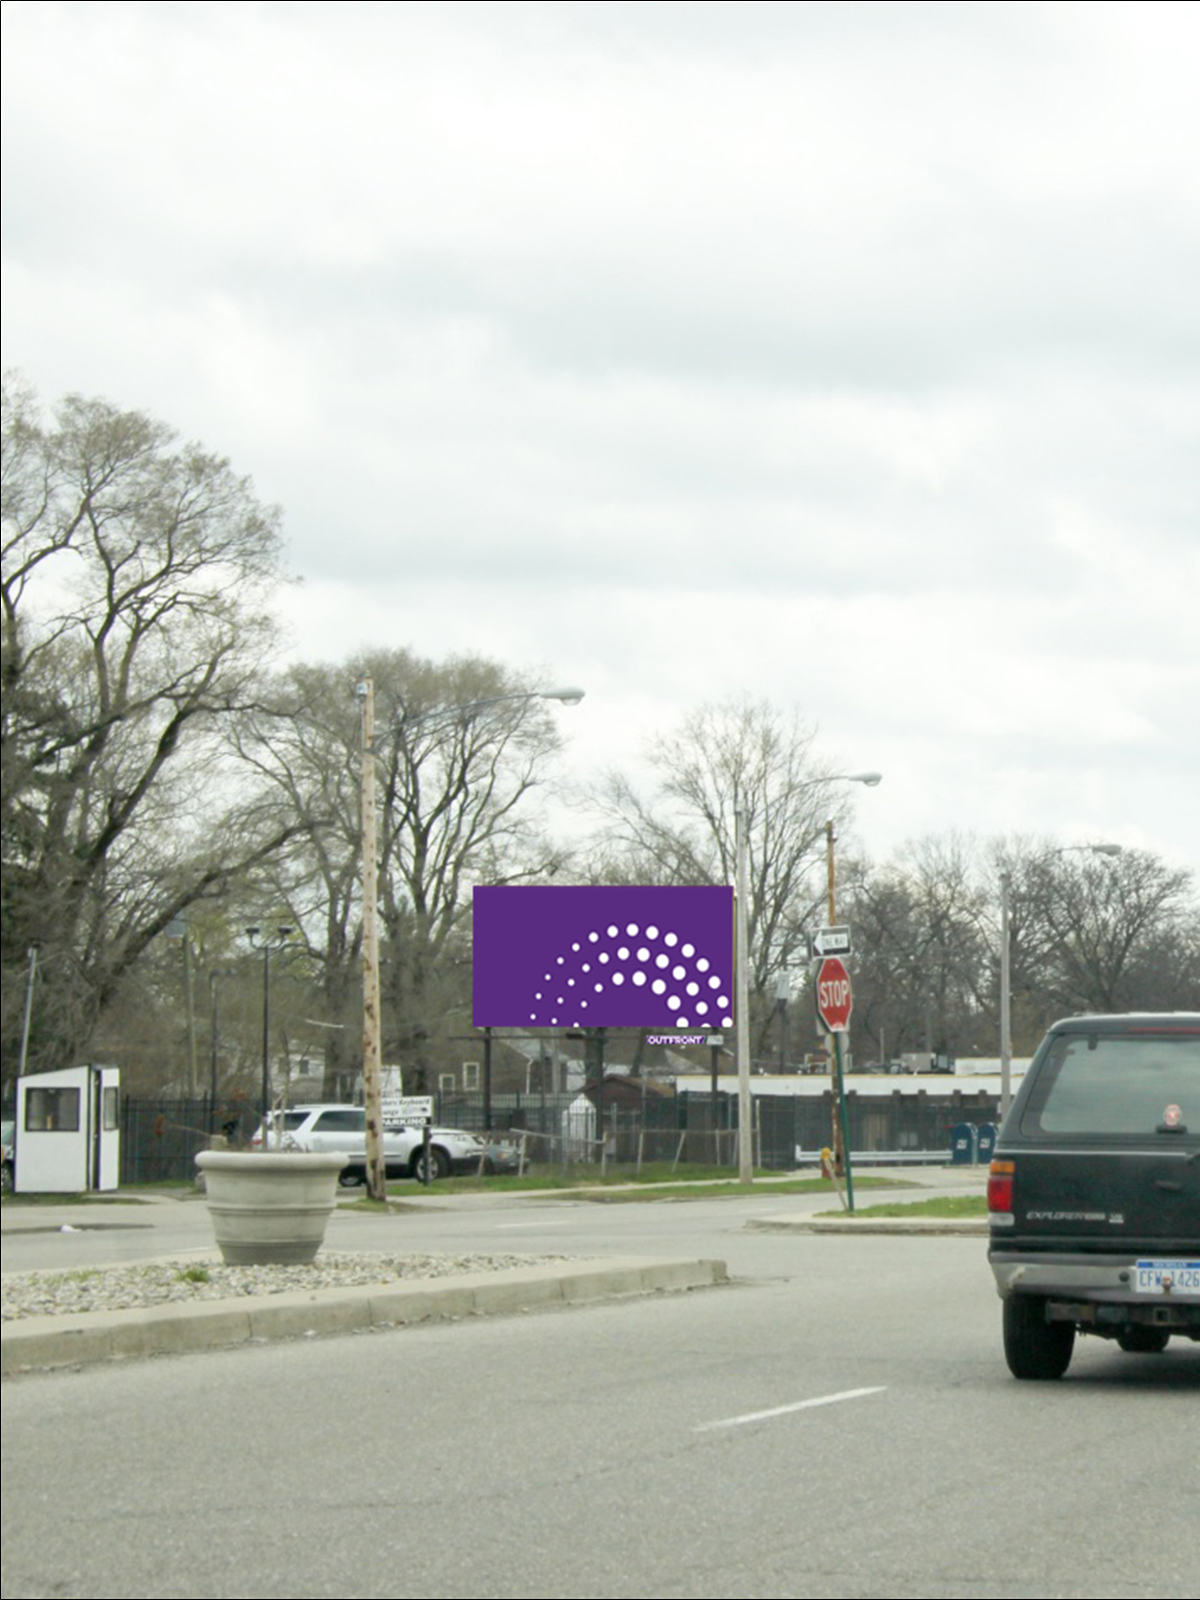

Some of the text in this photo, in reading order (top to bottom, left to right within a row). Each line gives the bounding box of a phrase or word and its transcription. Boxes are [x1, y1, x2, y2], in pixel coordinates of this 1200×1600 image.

[820, 980, 848, 1008] STOP
[647, 1035, 703, 1045] OUTFRONT
[1026, 1211, 1084, 1220] EXPLORER
